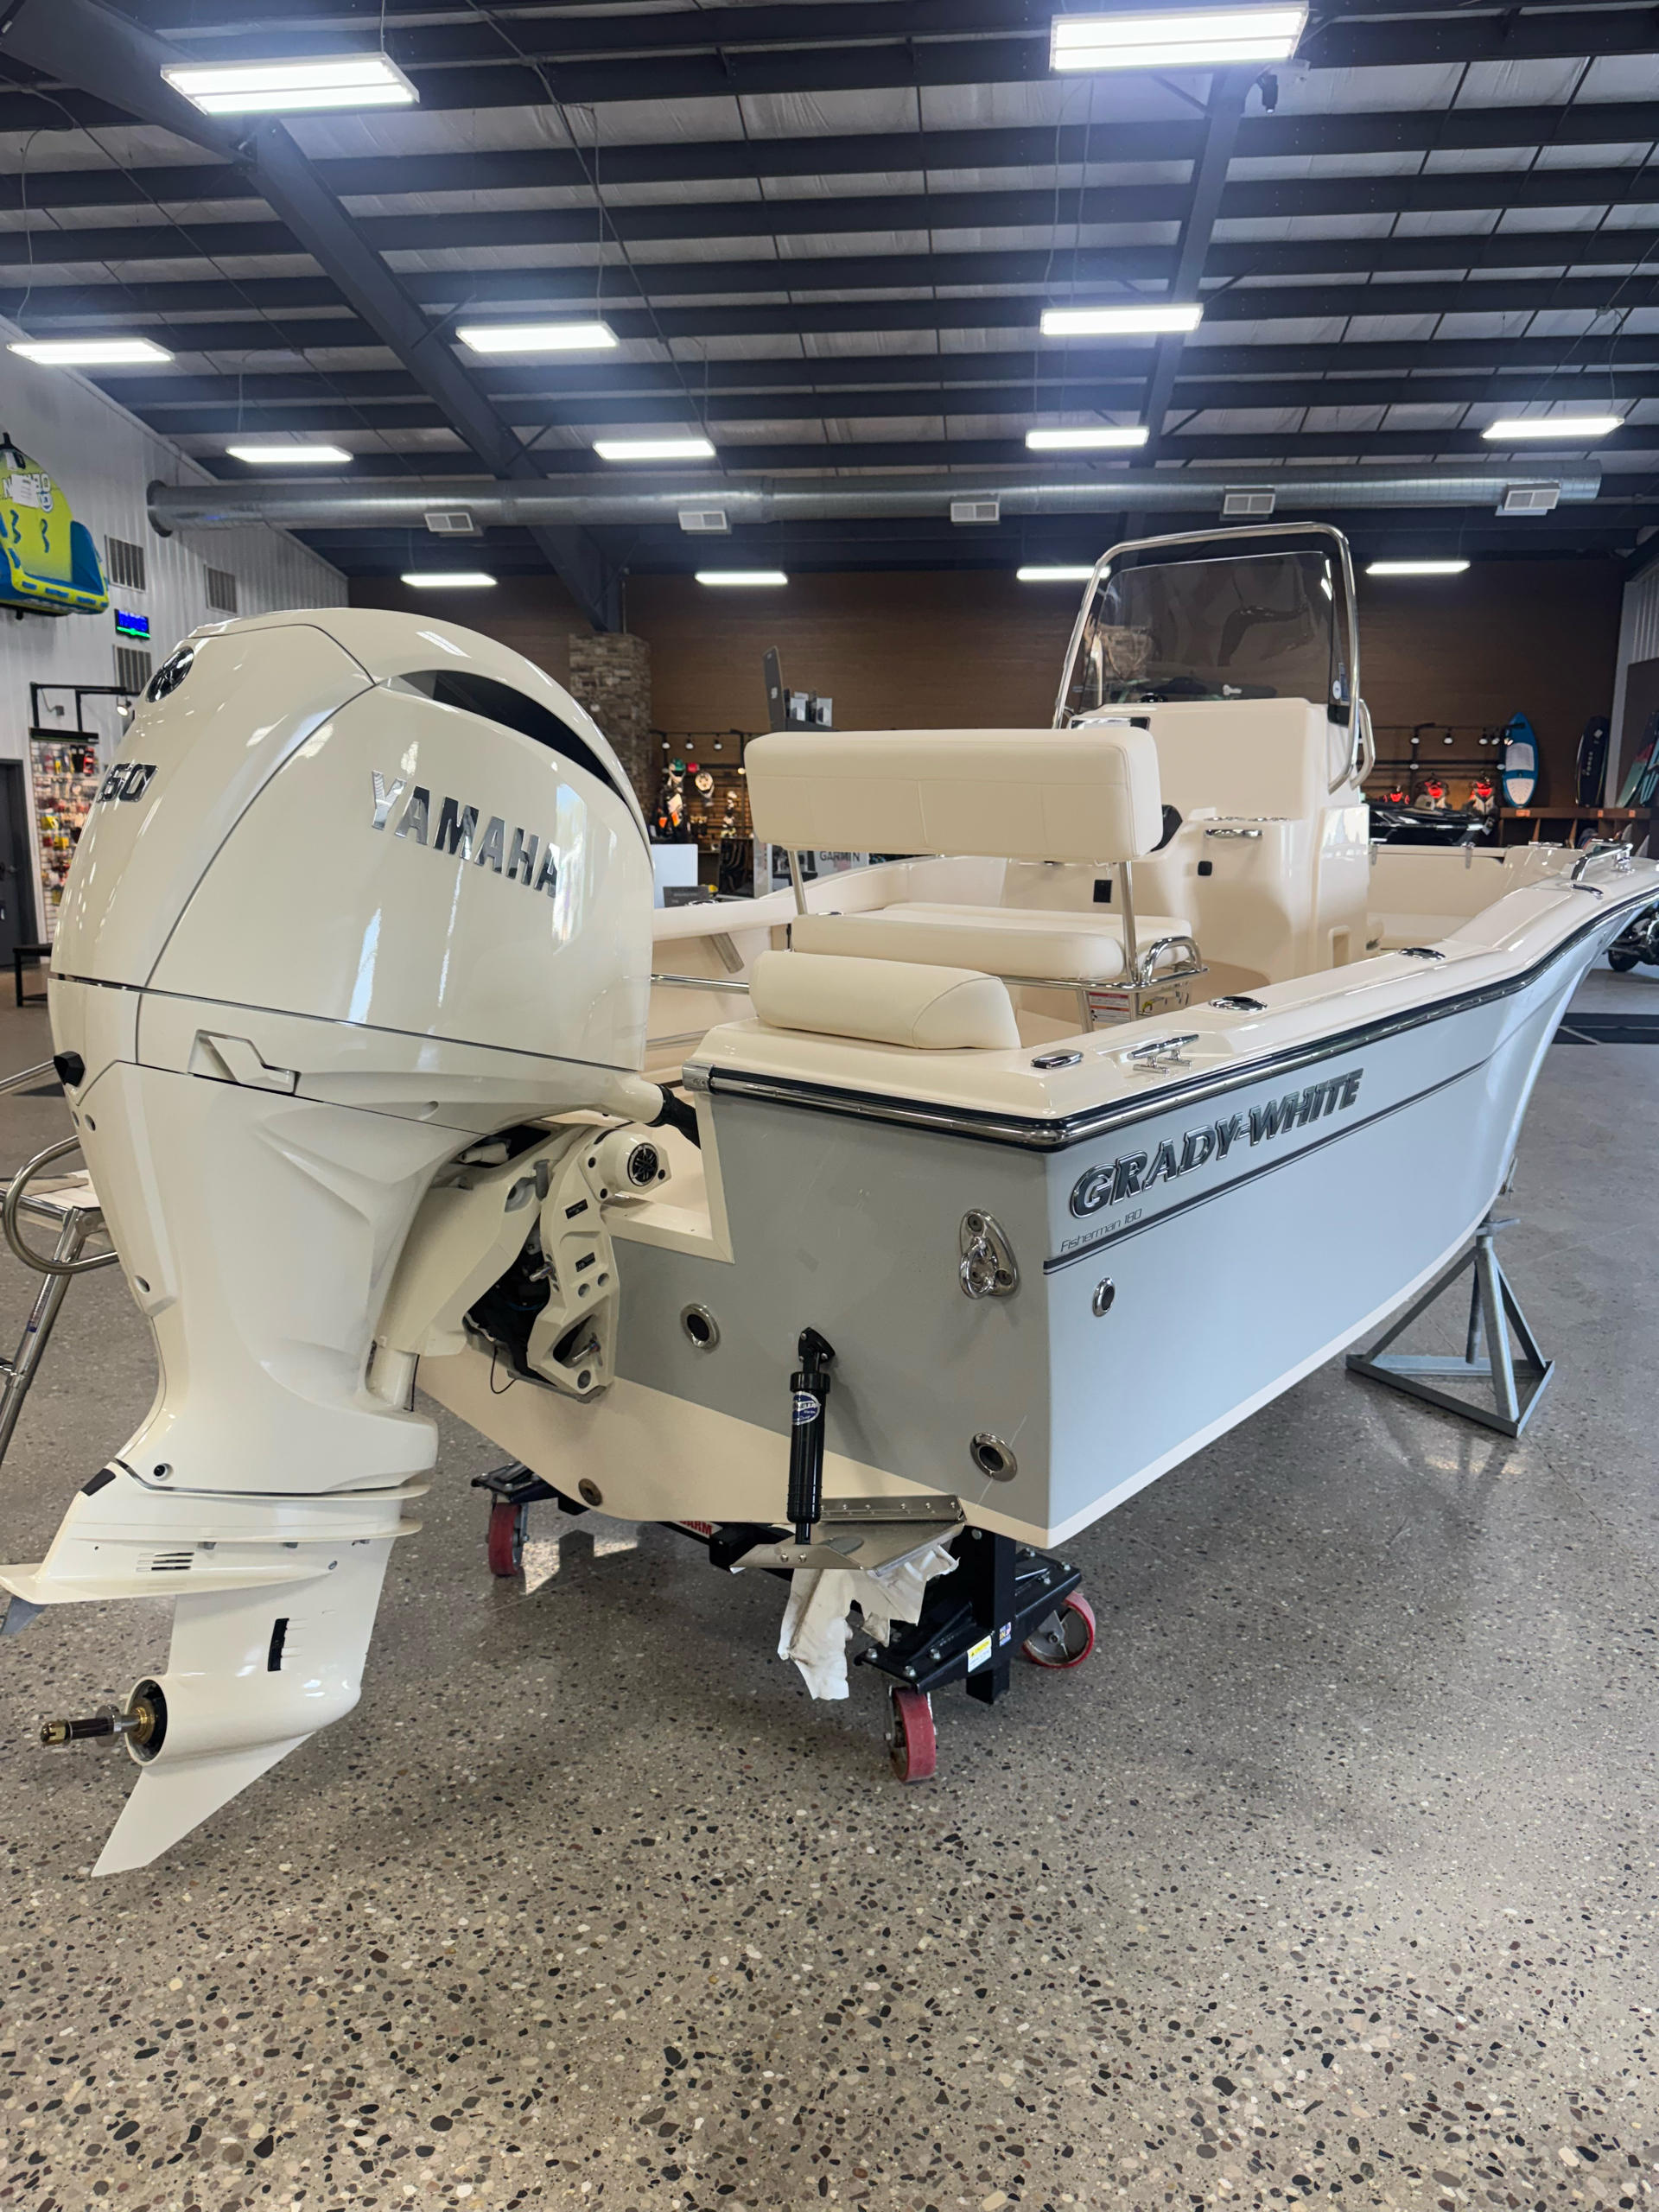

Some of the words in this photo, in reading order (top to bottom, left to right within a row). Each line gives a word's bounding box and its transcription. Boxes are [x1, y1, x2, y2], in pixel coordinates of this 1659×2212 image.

[372, 770, 561, 898] YAMAHA
[819, 850, 861, 862] GARMIN
[1069, 1068, 1363, 1219] GRADY-WHITE
[1060, 1220, 1121, 1252] Fisherman
[1124, 1208, 1142, 1224] 180
